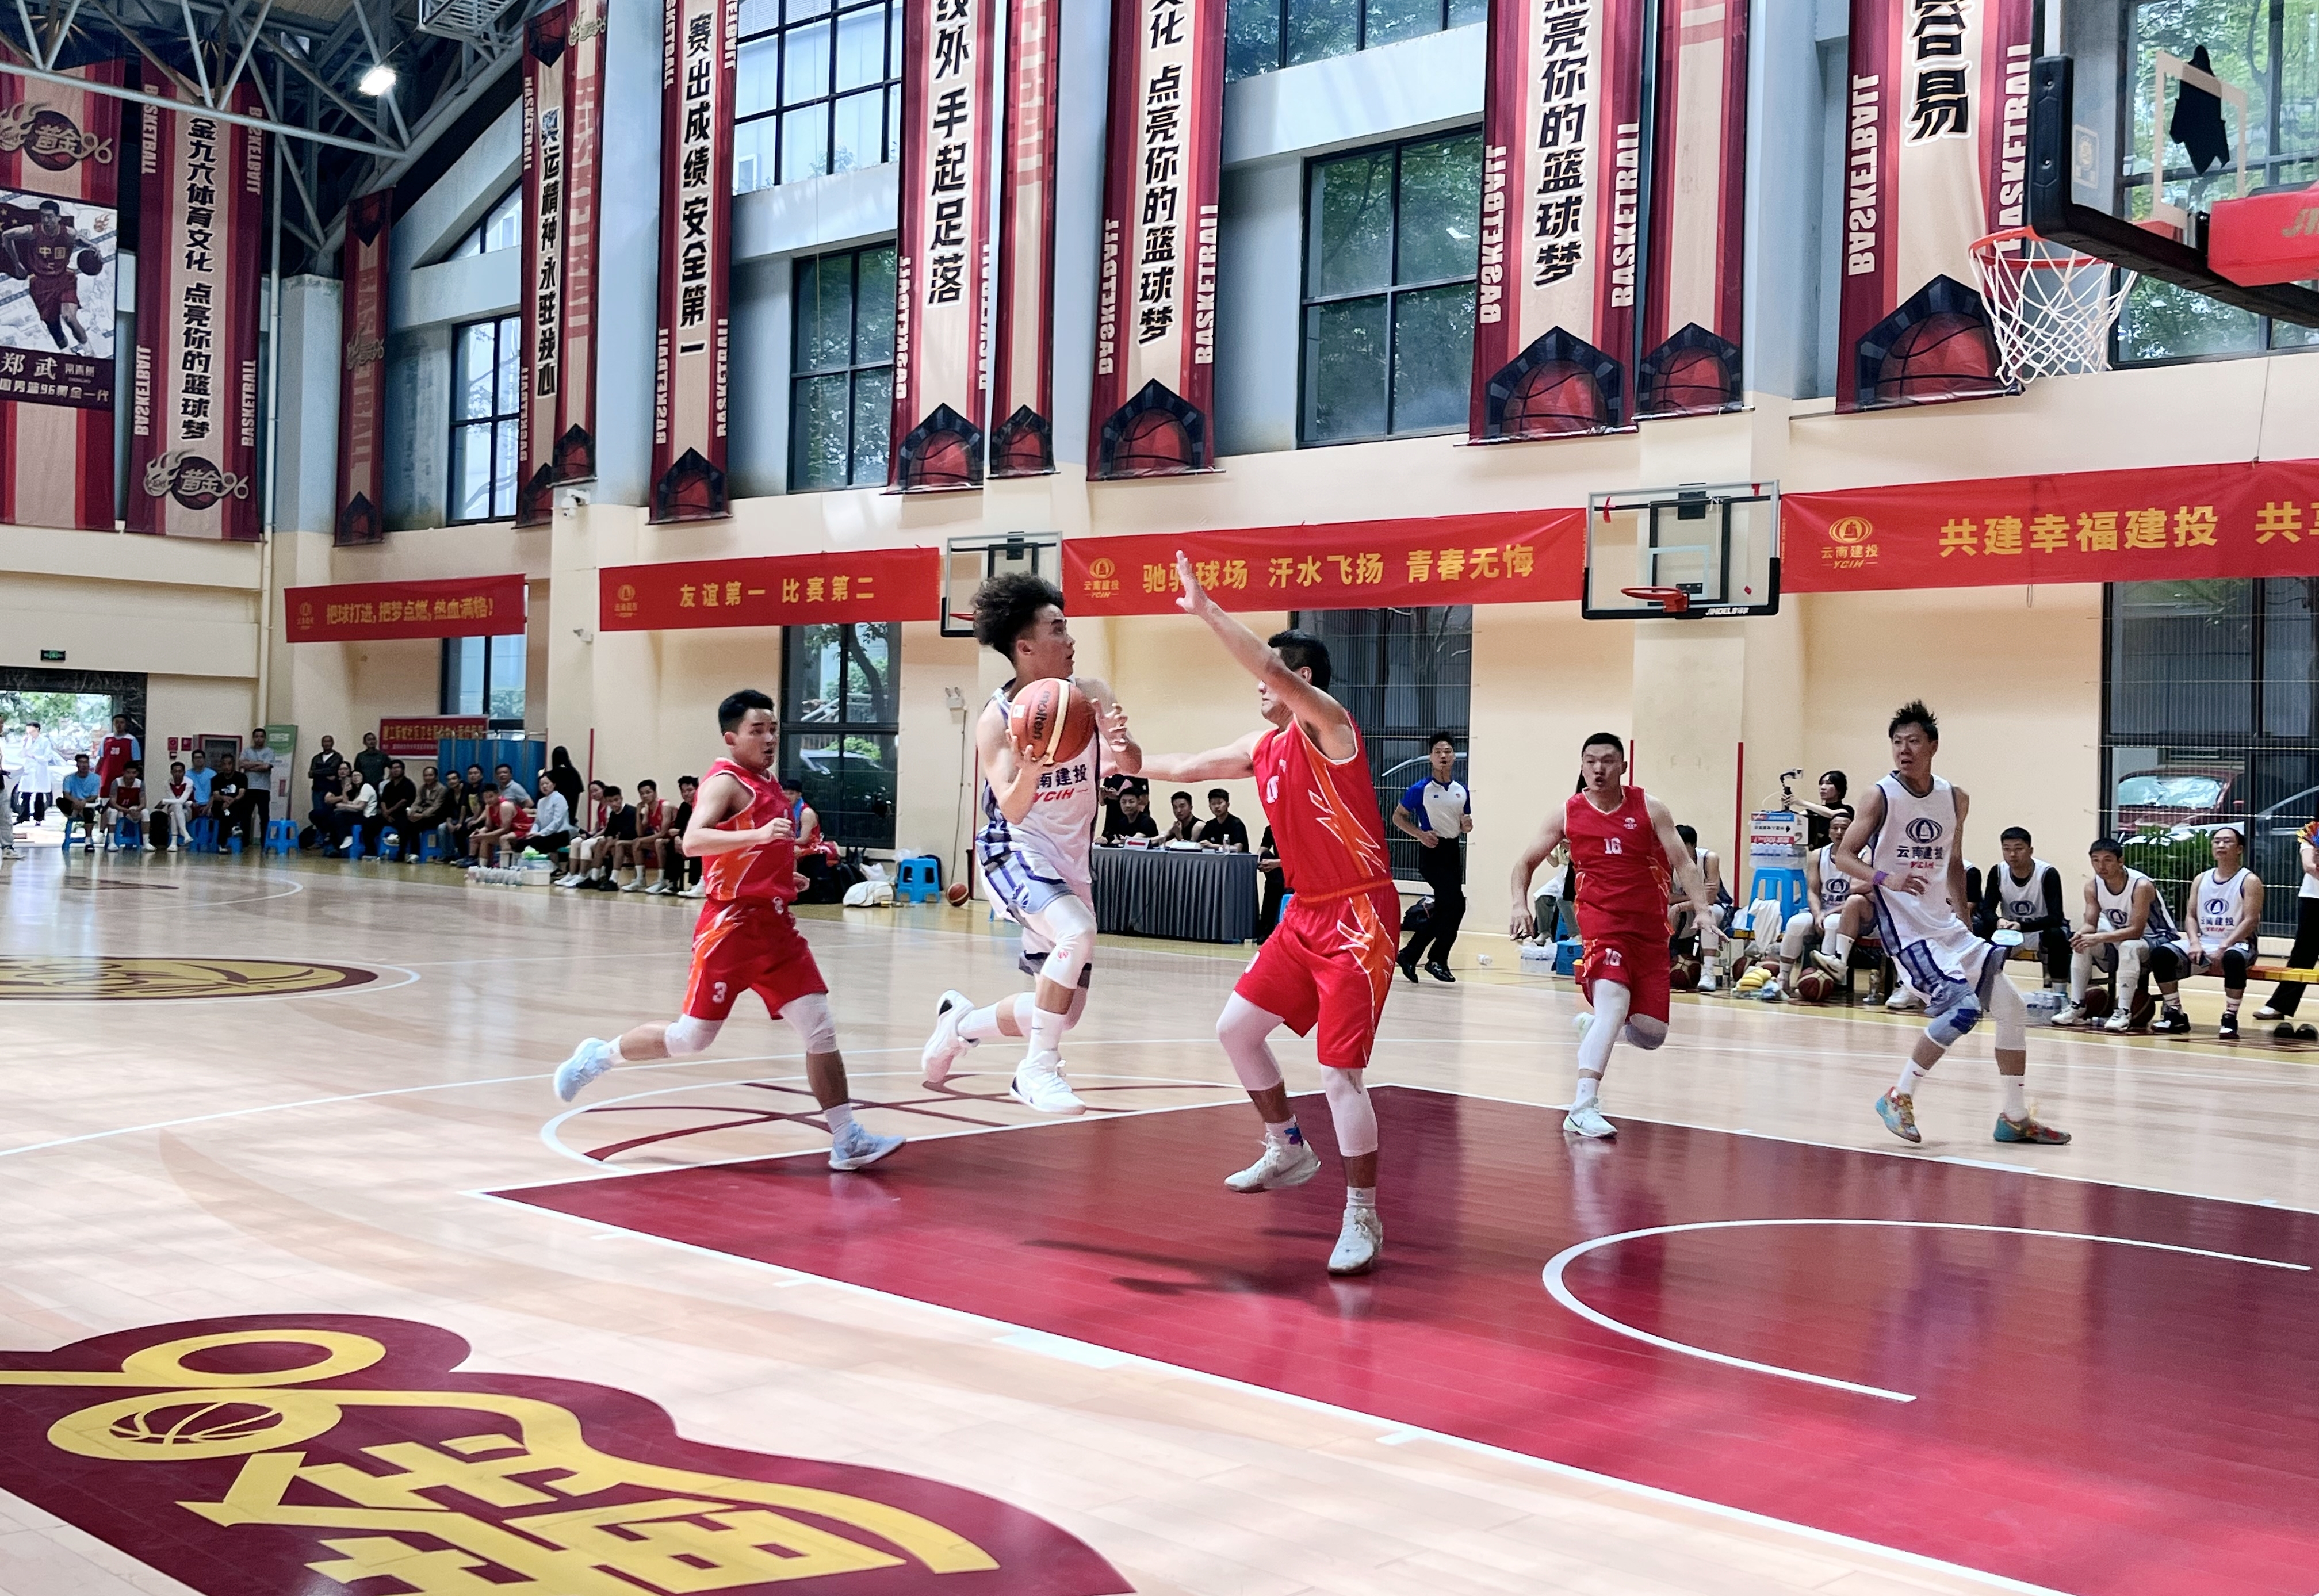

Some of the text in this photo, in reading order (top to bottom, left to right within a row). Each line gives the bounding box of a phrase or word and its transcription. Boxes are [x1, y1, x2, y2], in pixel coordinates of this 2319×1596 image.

[141, 84, 159, 174] BSKETBALL
[1534, 0, 1589, 287] 亮你的篮球梦
[1139, 64, 1182, 345] 点亮你的篮球梦
[1611, 121, 1640, 308] BASKETBALL
[181, 98, 217, 440] 金九六体育文化 点亮你的篮球梦
[1194, 205, 1218, 365] BASKETBALL
[242, 359, 256, 447] BASKETBALL
[1268, 552, 1385, 588] 汗水飞扬
[1406, 544, 1534, 583] 青春无悔
[1821, 544, 1878, 559] 云南建投
[1939, 500, 2319, 559] 共建幸福建投 共
[679, 575, 874, 608] 友谊第一 比赛第二
[1038, 764, 1088, 789] 南建投
[1604, 837, 1623, 855] 16
[712, 982, 728, 1004] 3
